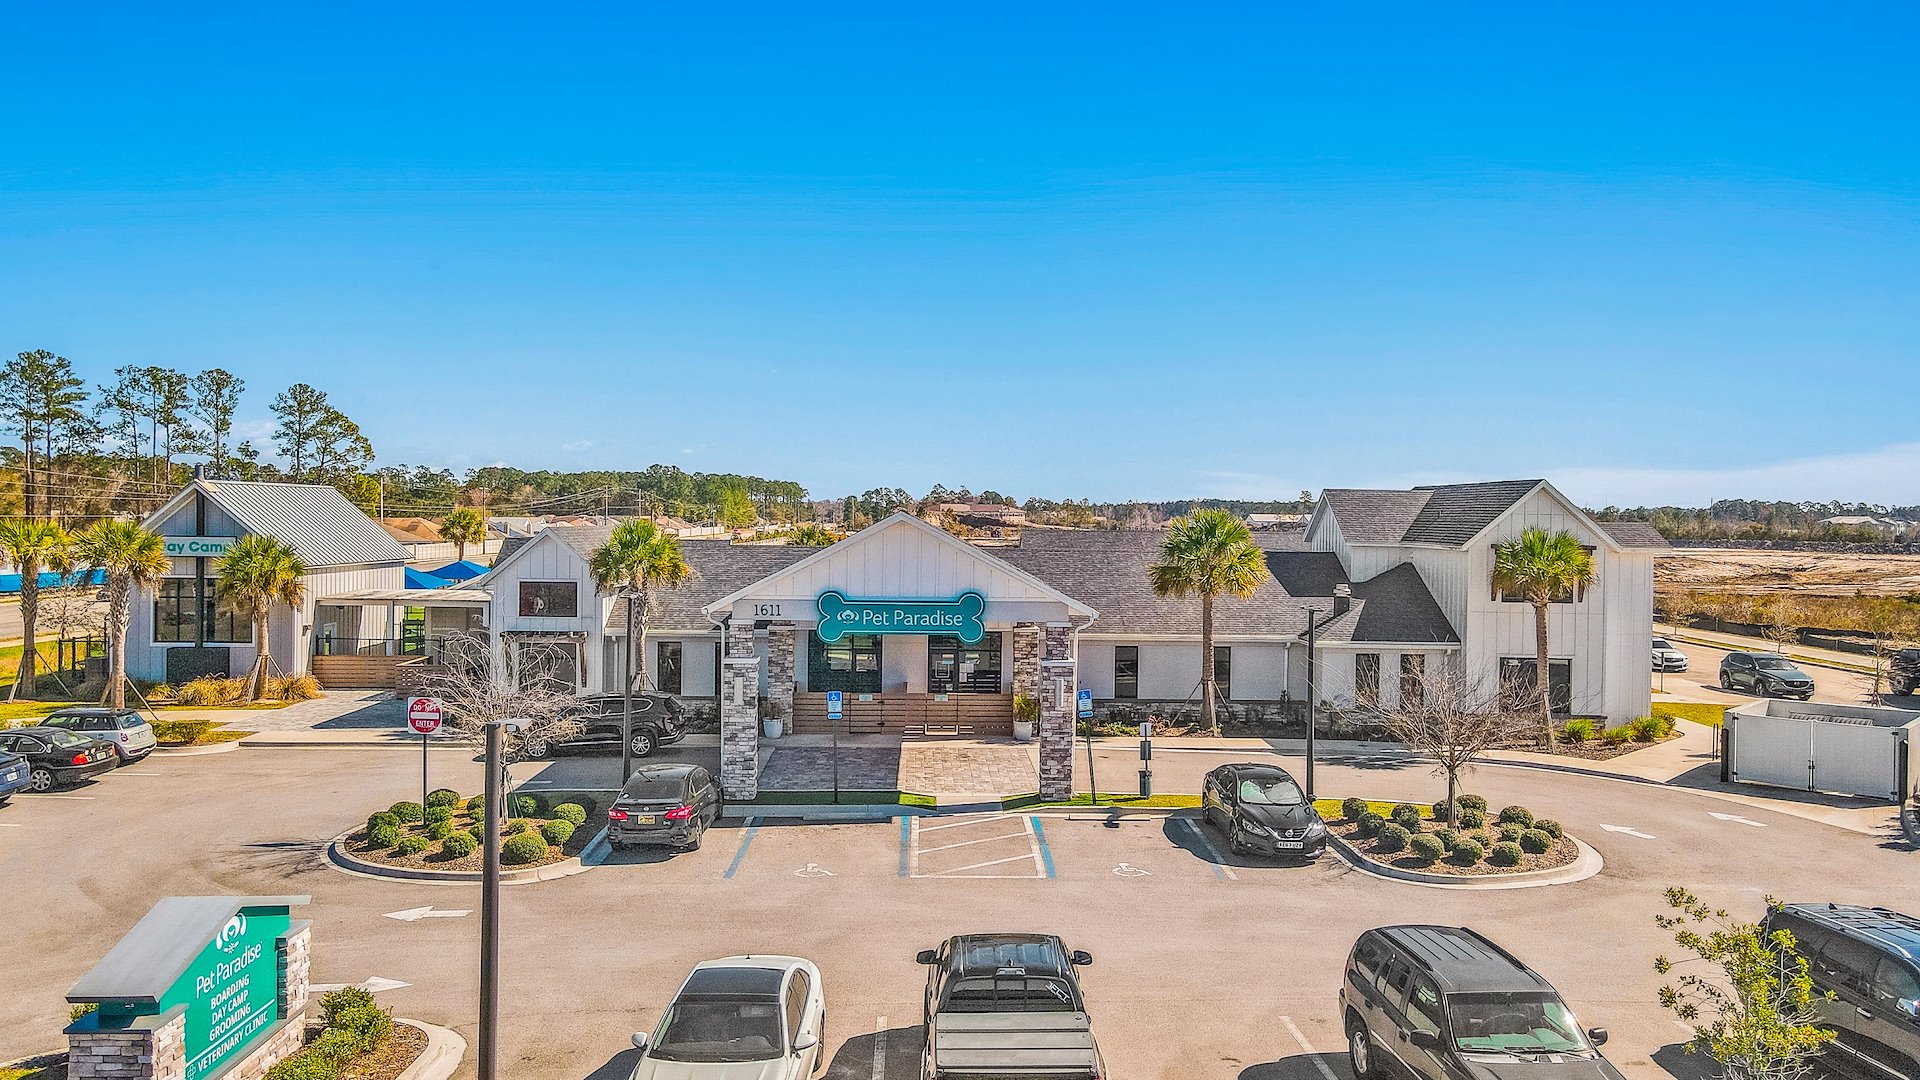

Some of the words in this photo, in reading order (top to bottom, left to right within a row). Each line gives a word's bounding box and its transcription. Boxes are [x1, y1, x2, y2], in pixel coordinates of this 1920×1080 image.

[164, 543, 185, 554] ay
[754, 604, 782, 616] 1611
[863, 609, 890, 626] Pet
[894, 609, 963, 626] Paradise
[196, 971, 216, 999] Pet
[216, 943, 262, 985] Paradise
[211, 973, 250, 1010] BOARDING
[212, 1003, 228, 1025] DAY
[228, 989, 249, 1013] CAMP
[209, 1002, 251, 1041] GROOMING
[197, 1028, 244, 1072] VETERINARY
[244, 1010, 268, 1037] CLINIC
